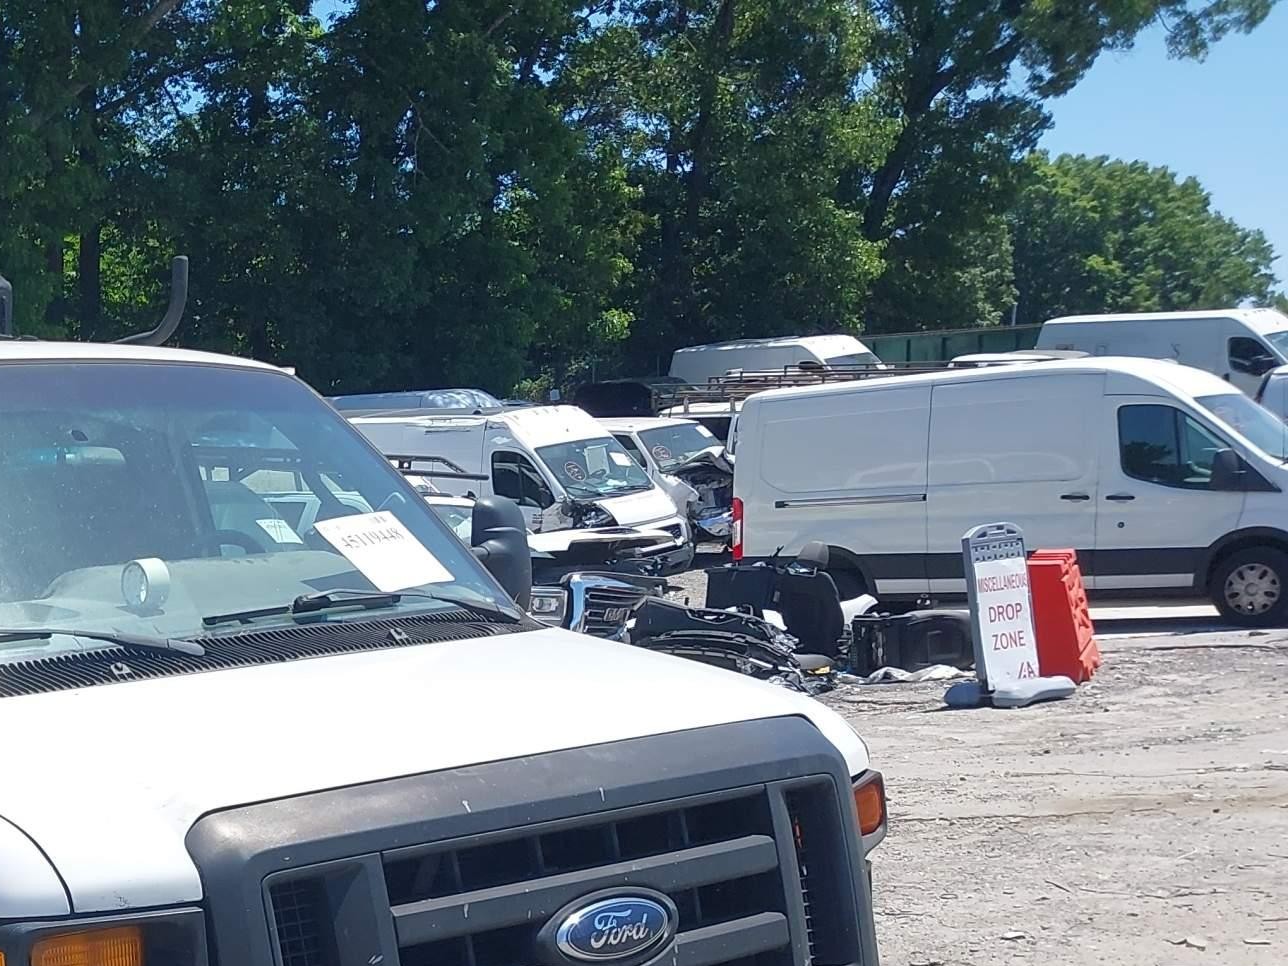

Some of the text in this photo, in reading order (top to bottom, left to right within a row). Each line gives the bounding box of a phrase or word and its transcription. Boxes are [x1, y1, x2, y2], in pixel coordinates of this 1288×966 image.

[977, 572, 1028, 593] MISCELLANEOUS
[988, 602, 1023, 623] DROP
[992, 630, 1026, 651] ZONE
[590, 909, 649, 949] Ford
